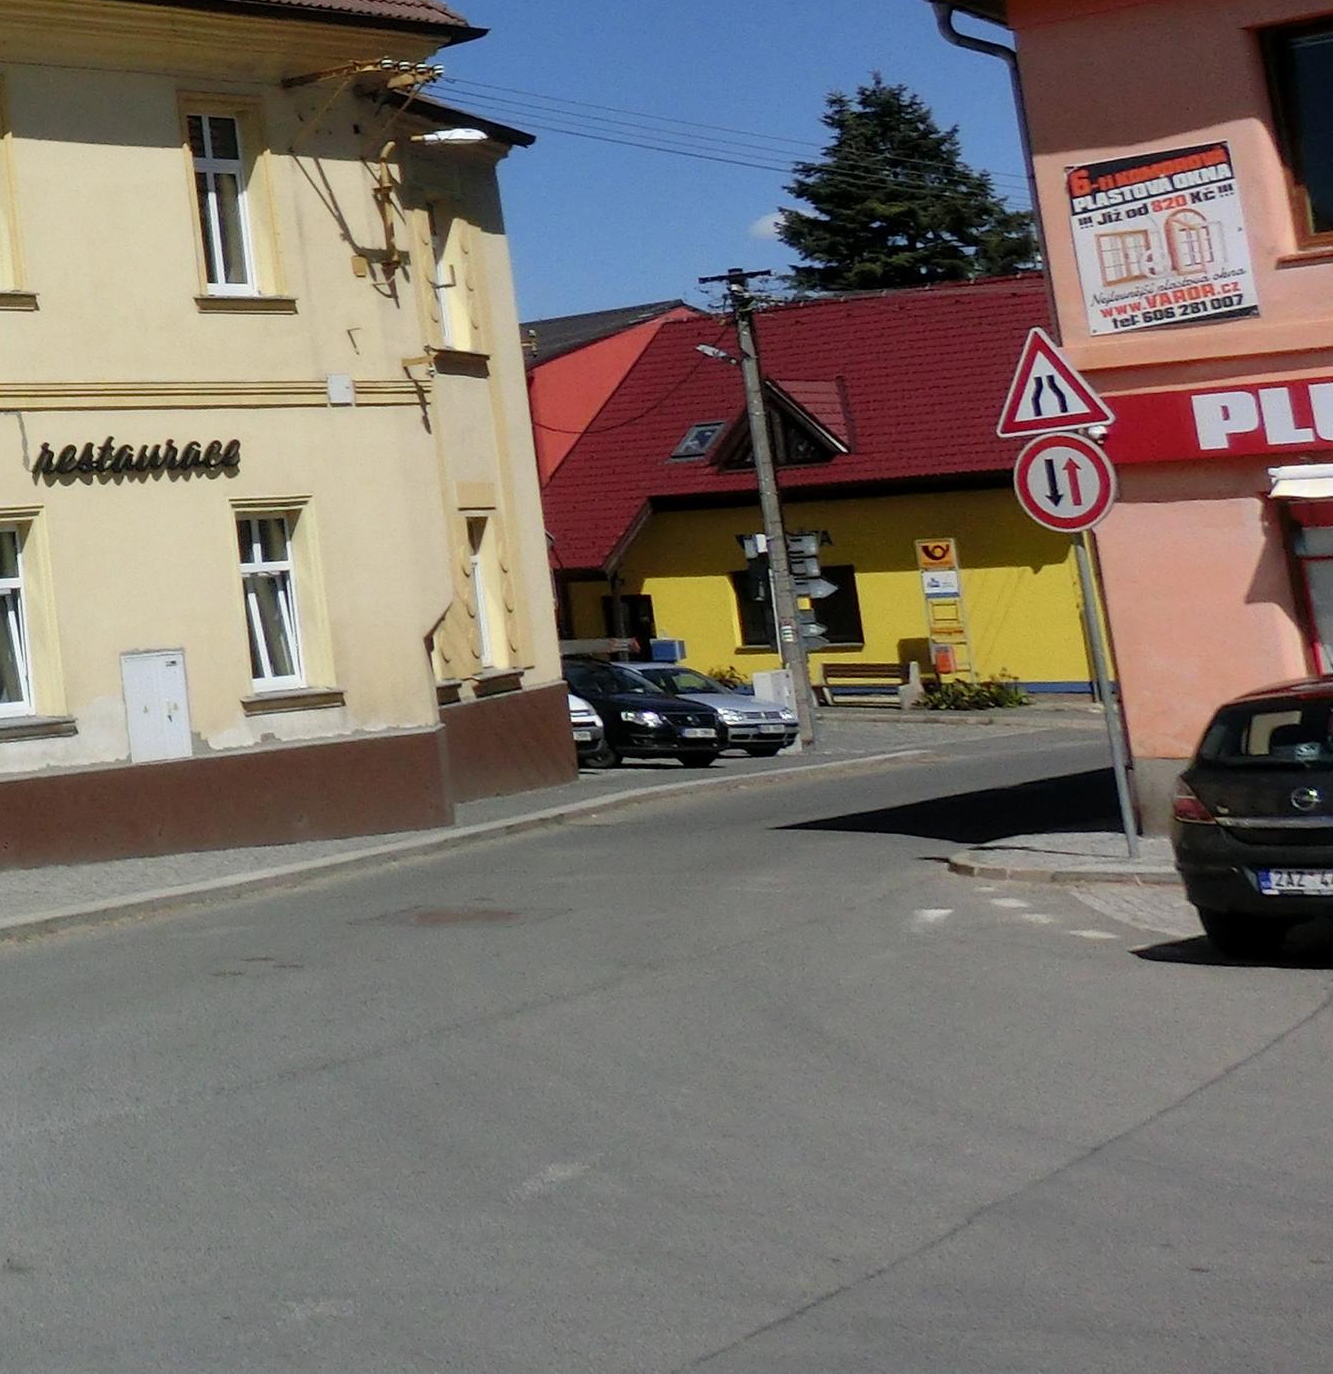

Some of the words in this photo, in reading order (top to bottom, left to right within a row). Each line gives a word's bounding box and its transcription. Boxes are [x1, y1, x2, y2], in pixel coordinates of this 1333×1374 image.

[1173, 163, 1232, 187] OKNA
[1125, 204, 1149, 219] od
[1150, 194, 1187, 213] 820
[1190, 187, 1216, 205] Kč
[1143, 307, 1175, 323] 606
[1179, 300, 1207, 316] 281
[1211, 294, 1243, 309] 007
[33, 436, 242, 476] restaurace
